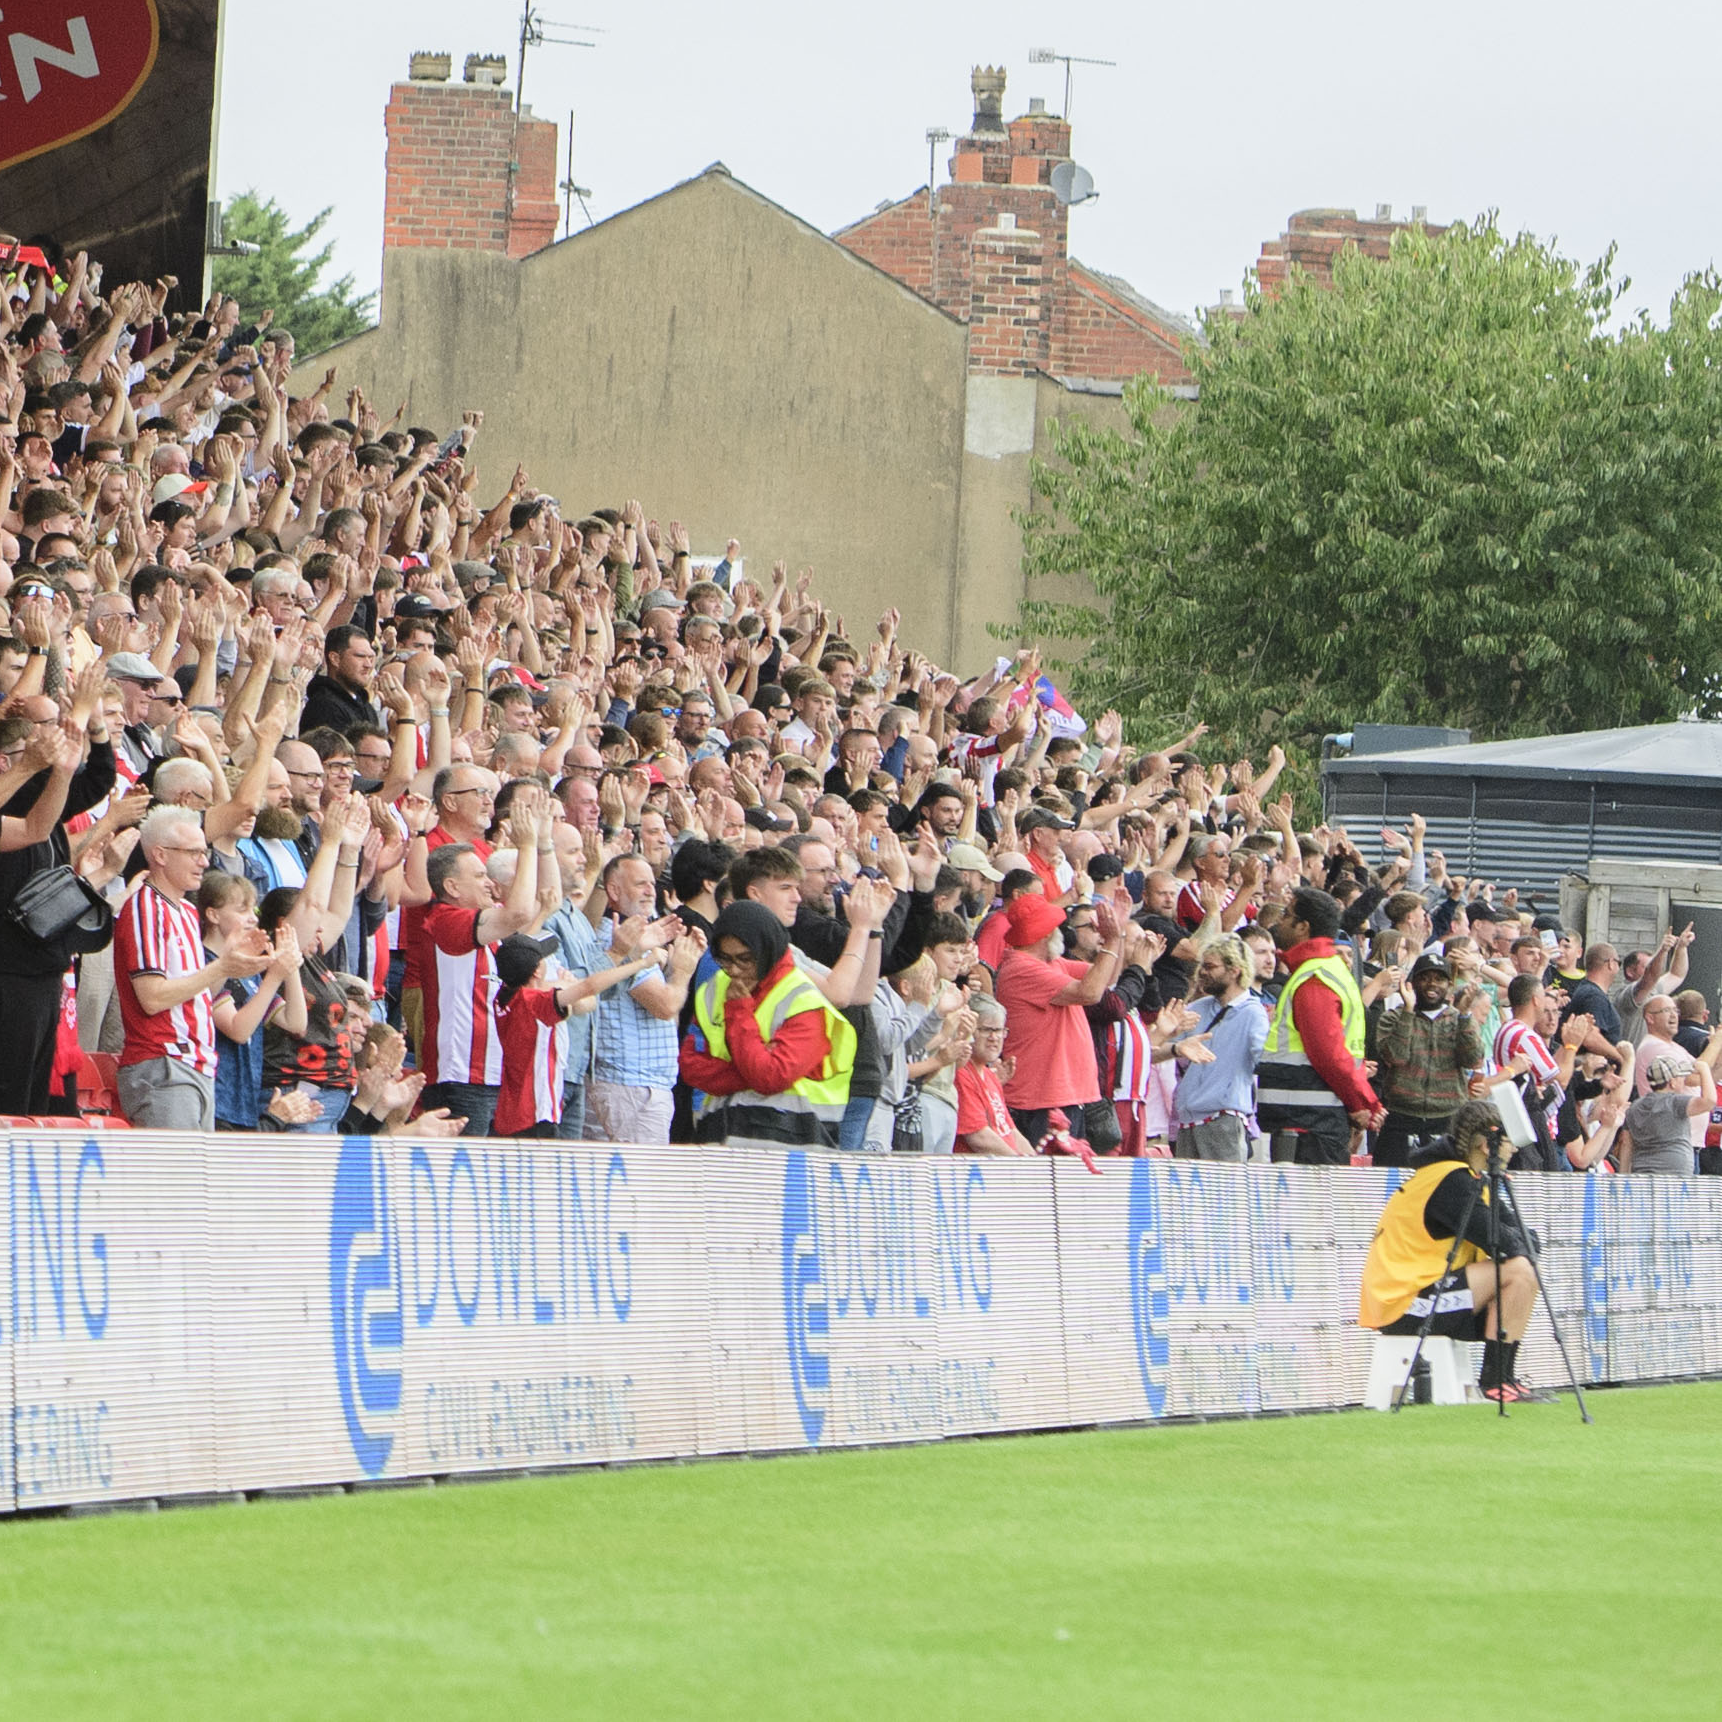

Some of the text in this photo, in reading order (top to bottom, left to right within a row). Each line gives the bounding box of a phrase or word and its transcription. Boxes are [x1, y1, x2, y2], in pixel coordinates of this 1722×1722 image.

[410, 1143, 632, 1327] DOWLING
[829, 1162, 993, 1318] DOWLNG
[1169, 1166, 1294, 1304] DOWLNG
